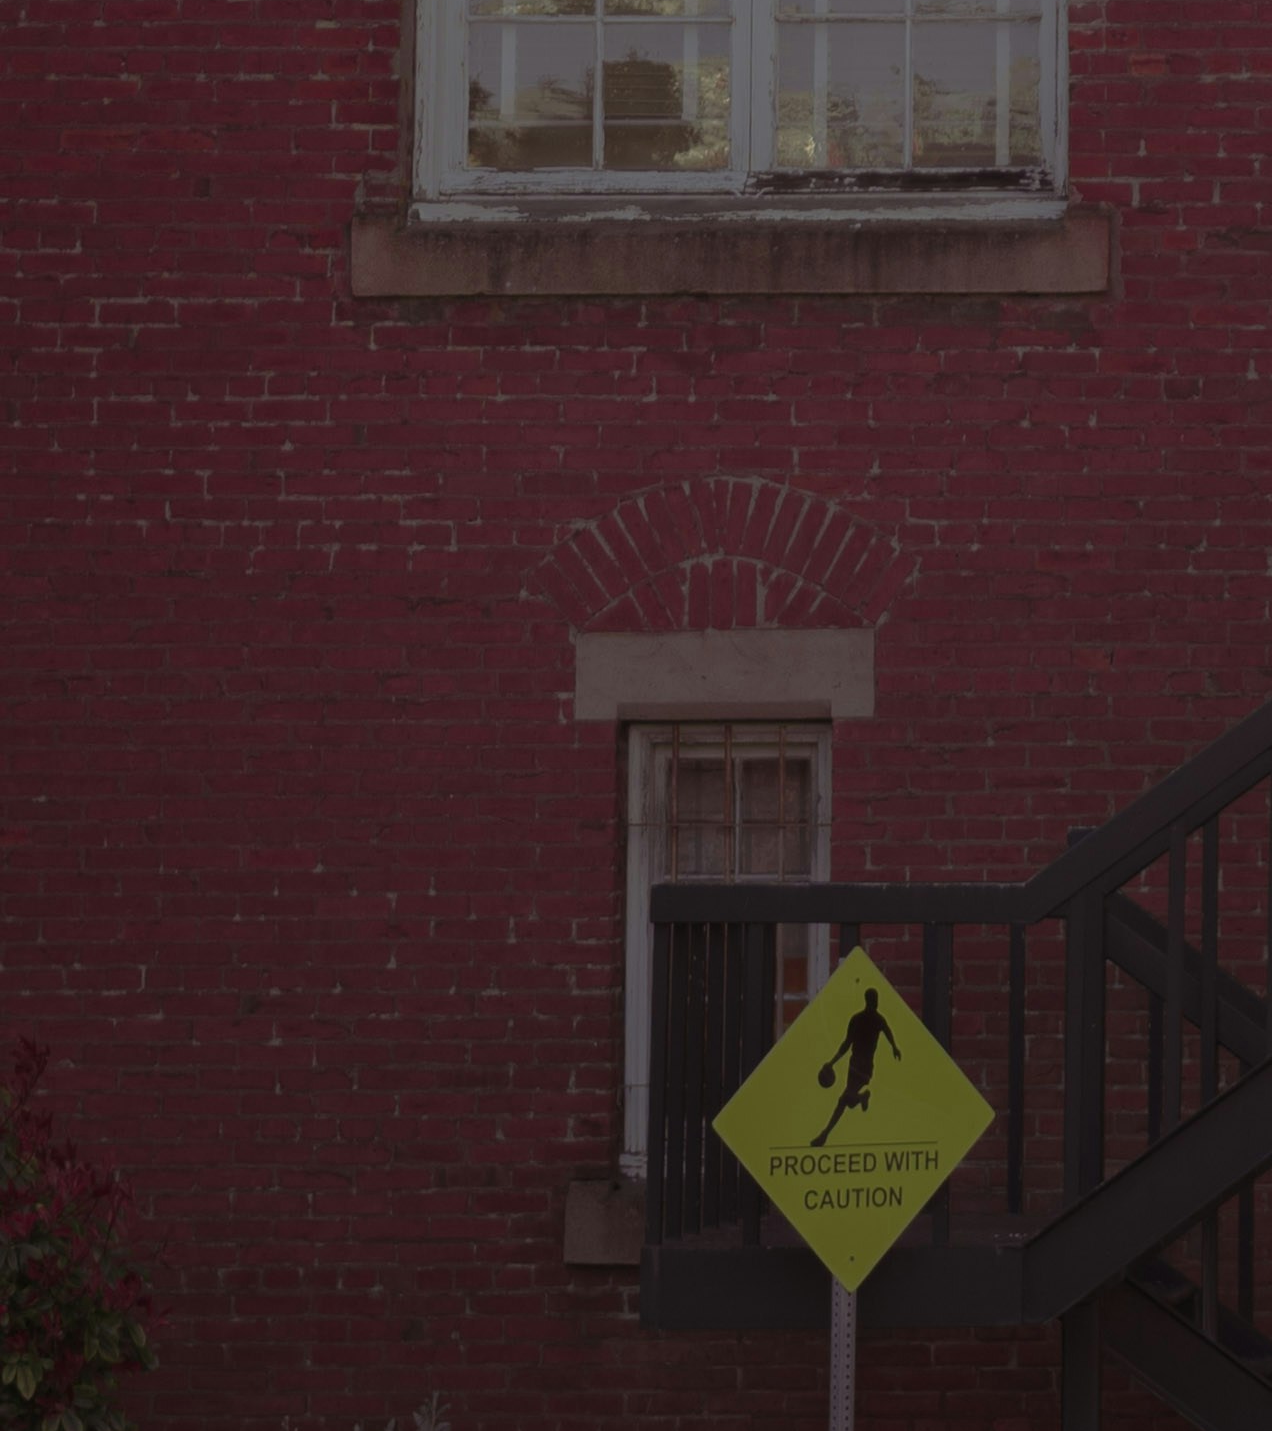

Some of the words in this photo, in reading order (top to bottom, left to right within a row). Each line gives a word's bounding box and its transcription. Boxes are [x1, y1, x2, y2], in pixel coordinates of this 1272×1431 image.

[770, 1153, 876, 1175] PROCEED
[884, 1150, 939, 1171] WITH
[804, 1186, 903, 1210] CAUTION
